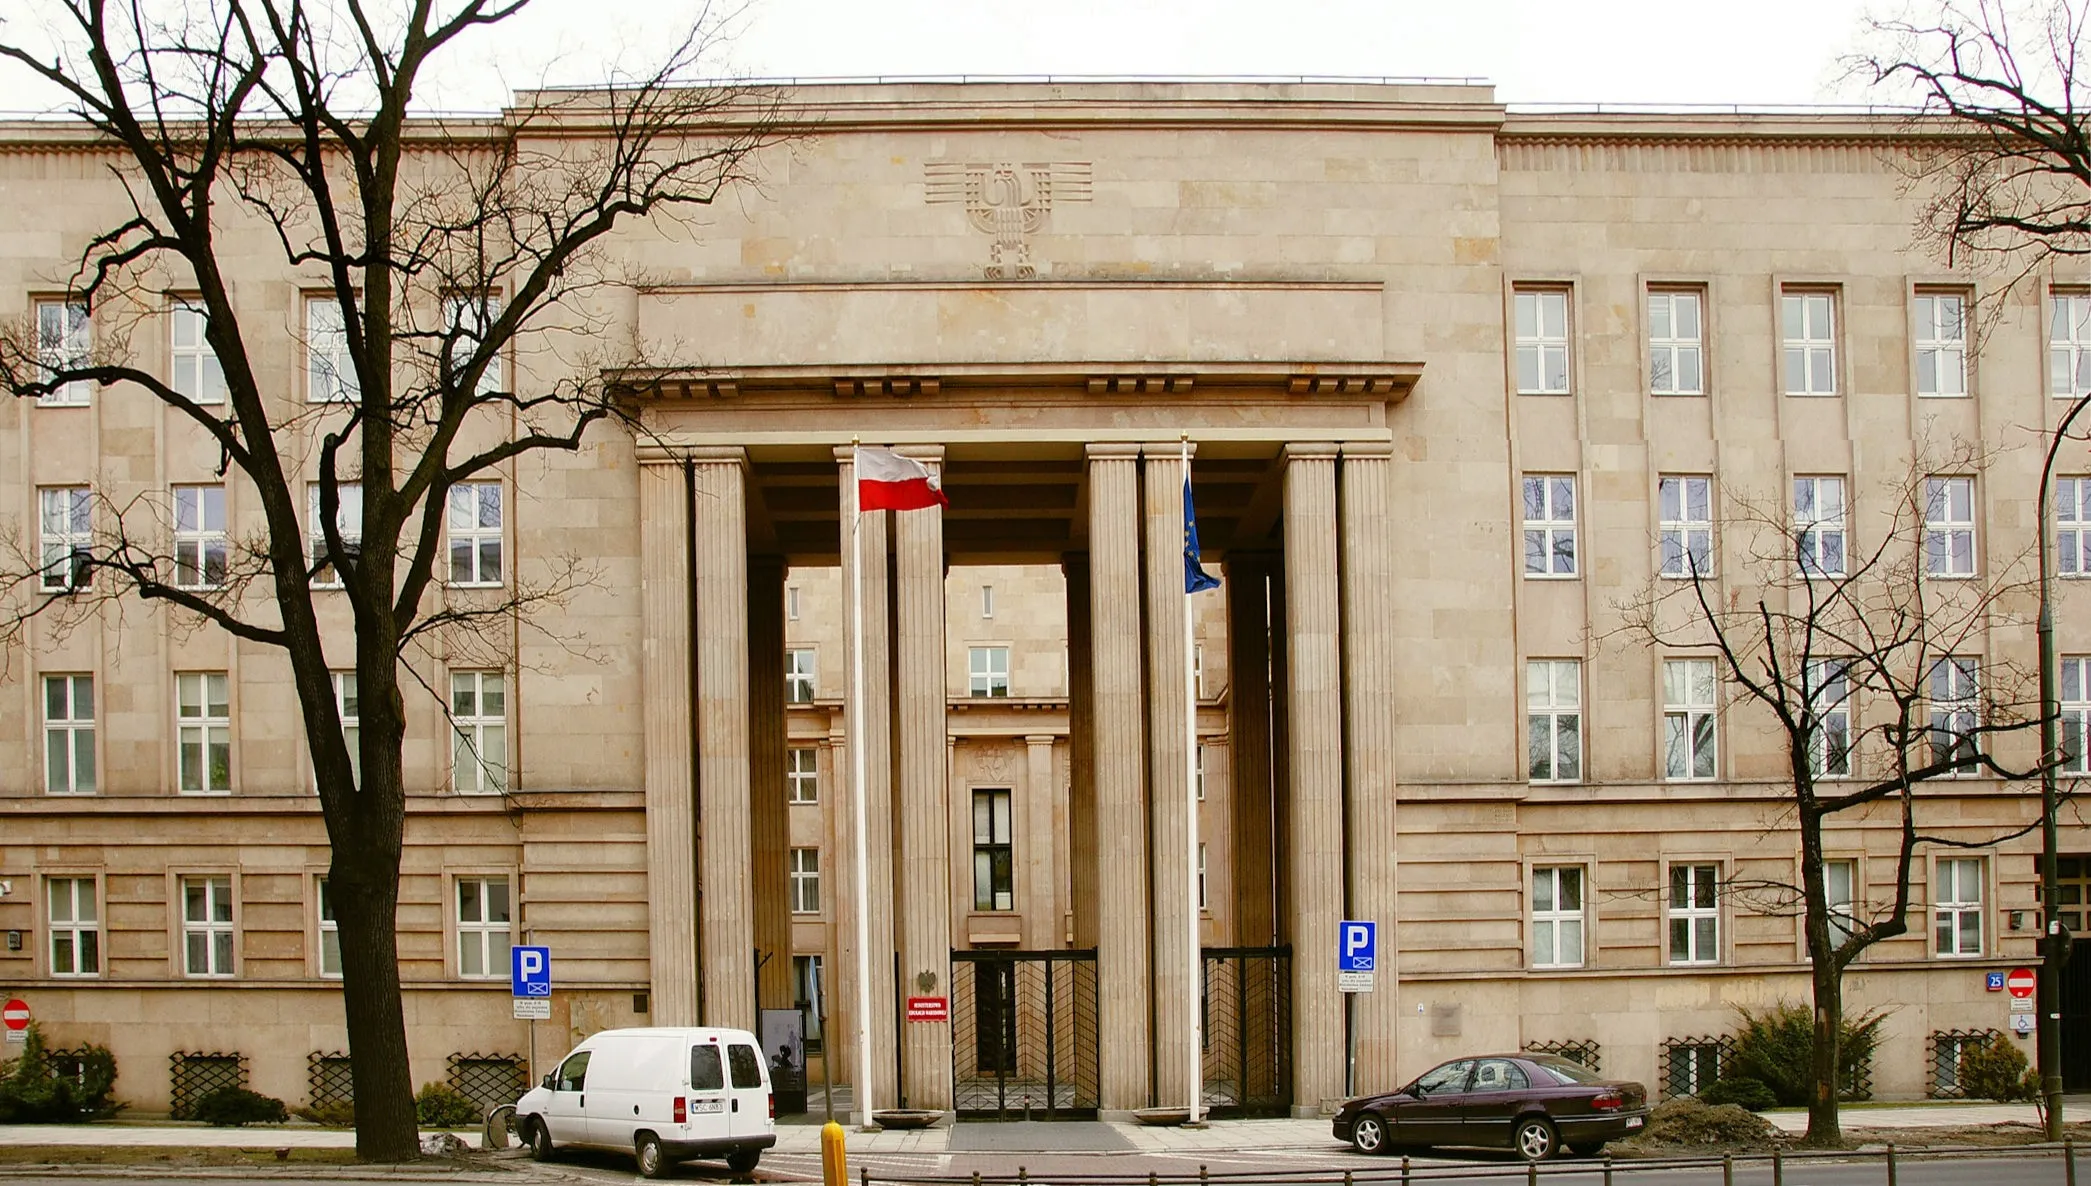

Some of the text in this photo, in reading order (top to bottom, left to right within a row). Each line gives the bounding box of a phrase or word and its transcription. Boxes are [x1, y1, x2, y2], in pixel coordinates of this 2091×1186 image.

[1347, 926, 1368, 957] P
[521, 951, 542, 982] P
[1990, 977, 2001, 987] 25
